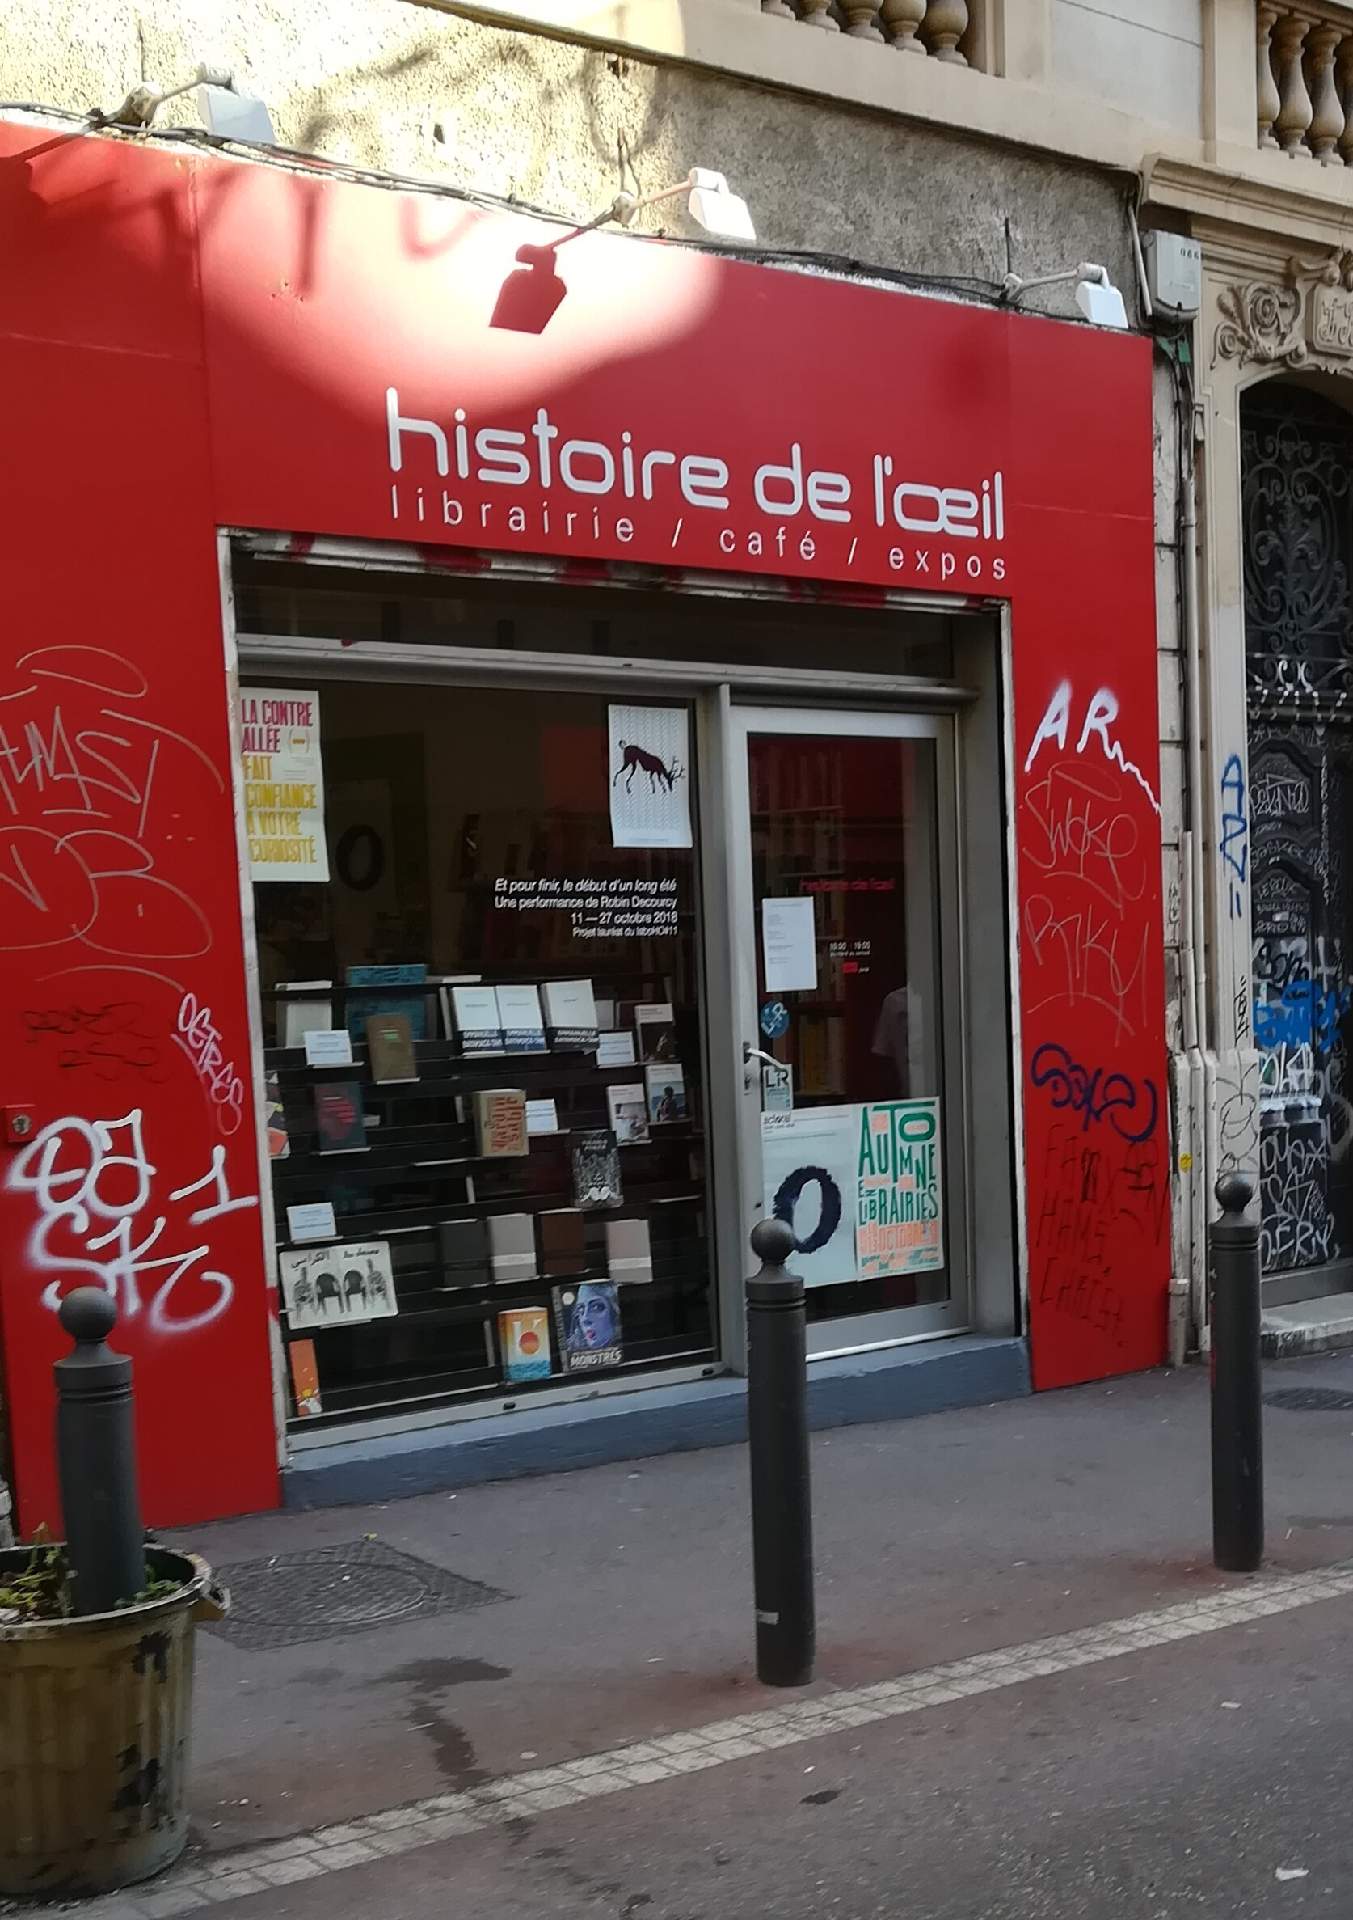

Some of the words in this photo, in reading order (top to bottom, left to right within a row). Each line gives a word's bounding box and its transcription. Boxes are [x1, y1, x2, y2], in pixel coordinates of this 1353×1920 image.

[385, 386, 729, 510] histoire
[754, 442, 852, 523] de
[874, 454, 1004, 541] l'œil
[389, 484, 635, 544] librairie
[719, 525, 816, 562] café
[888, 545, 1006, 582] expos
[241, 699, 258, 725] LA
[263, 700, 314, 728] CONTRE
[241, 725, 281, 754] ALLÉE
[243, 755, 273, 781] FAIT
[494, 878, 508, 892] Et
[508, 880, 537, 894] pour
[562, 879, 573, 892] le
[574, 879, 608, 892] début
[634, 879, 658, 895] long
[659, 878, 678, 892] été
[494, 896, 516, 909] Une
[518, 896, 584, 911] performance
[585, 896, 599, 908] de
[600, 896, 630, 908] Robin
[599, 912, 613, 924] 27
[613, 912, 652, 924] octobre
[858, 1183, 939, 1226] LIBRAIRIES
